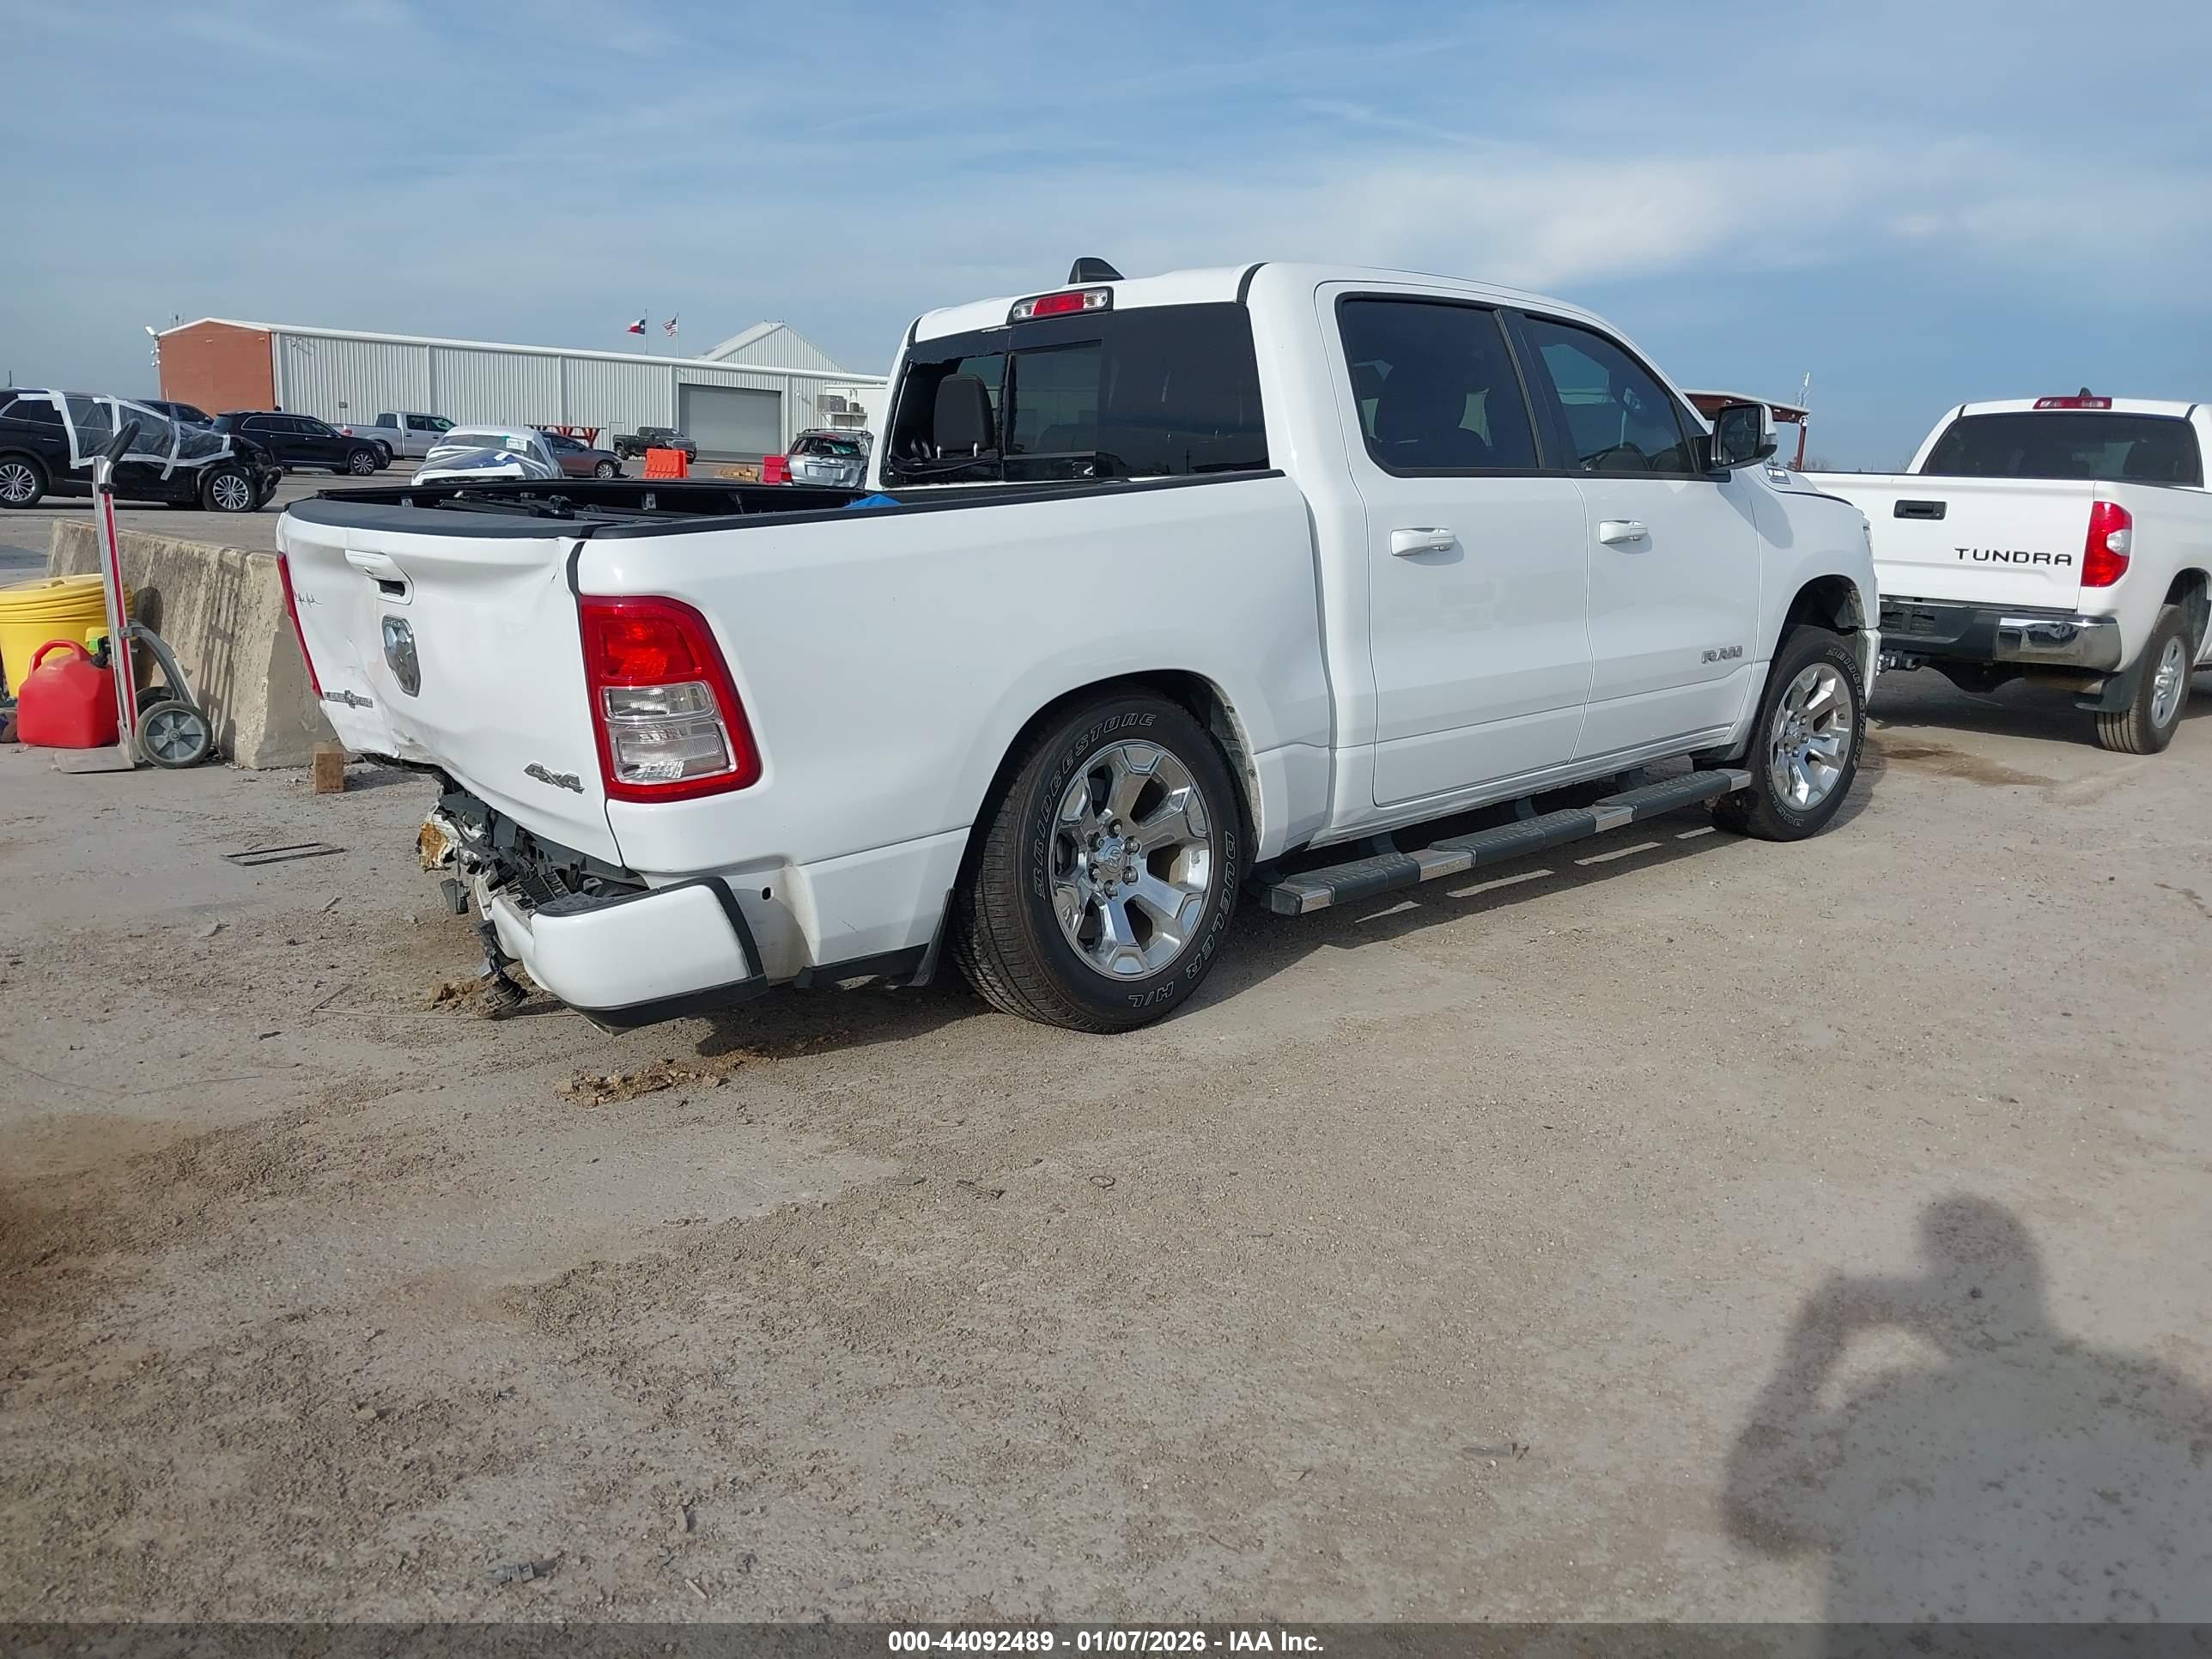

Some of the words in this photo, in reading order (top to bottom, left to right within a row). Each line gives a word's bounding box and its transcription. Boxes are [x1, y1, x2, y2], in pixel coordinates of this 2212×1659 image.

[1954, 547, 2072, 567] TUNDRA
[1701, 645, 1743, 664] RAM
[1034, 713, 1158, 900] BRIDGESTONE
[1186, 830, 1237, 980] DUELER
[1127, 981, 1175, 1007] H/L
